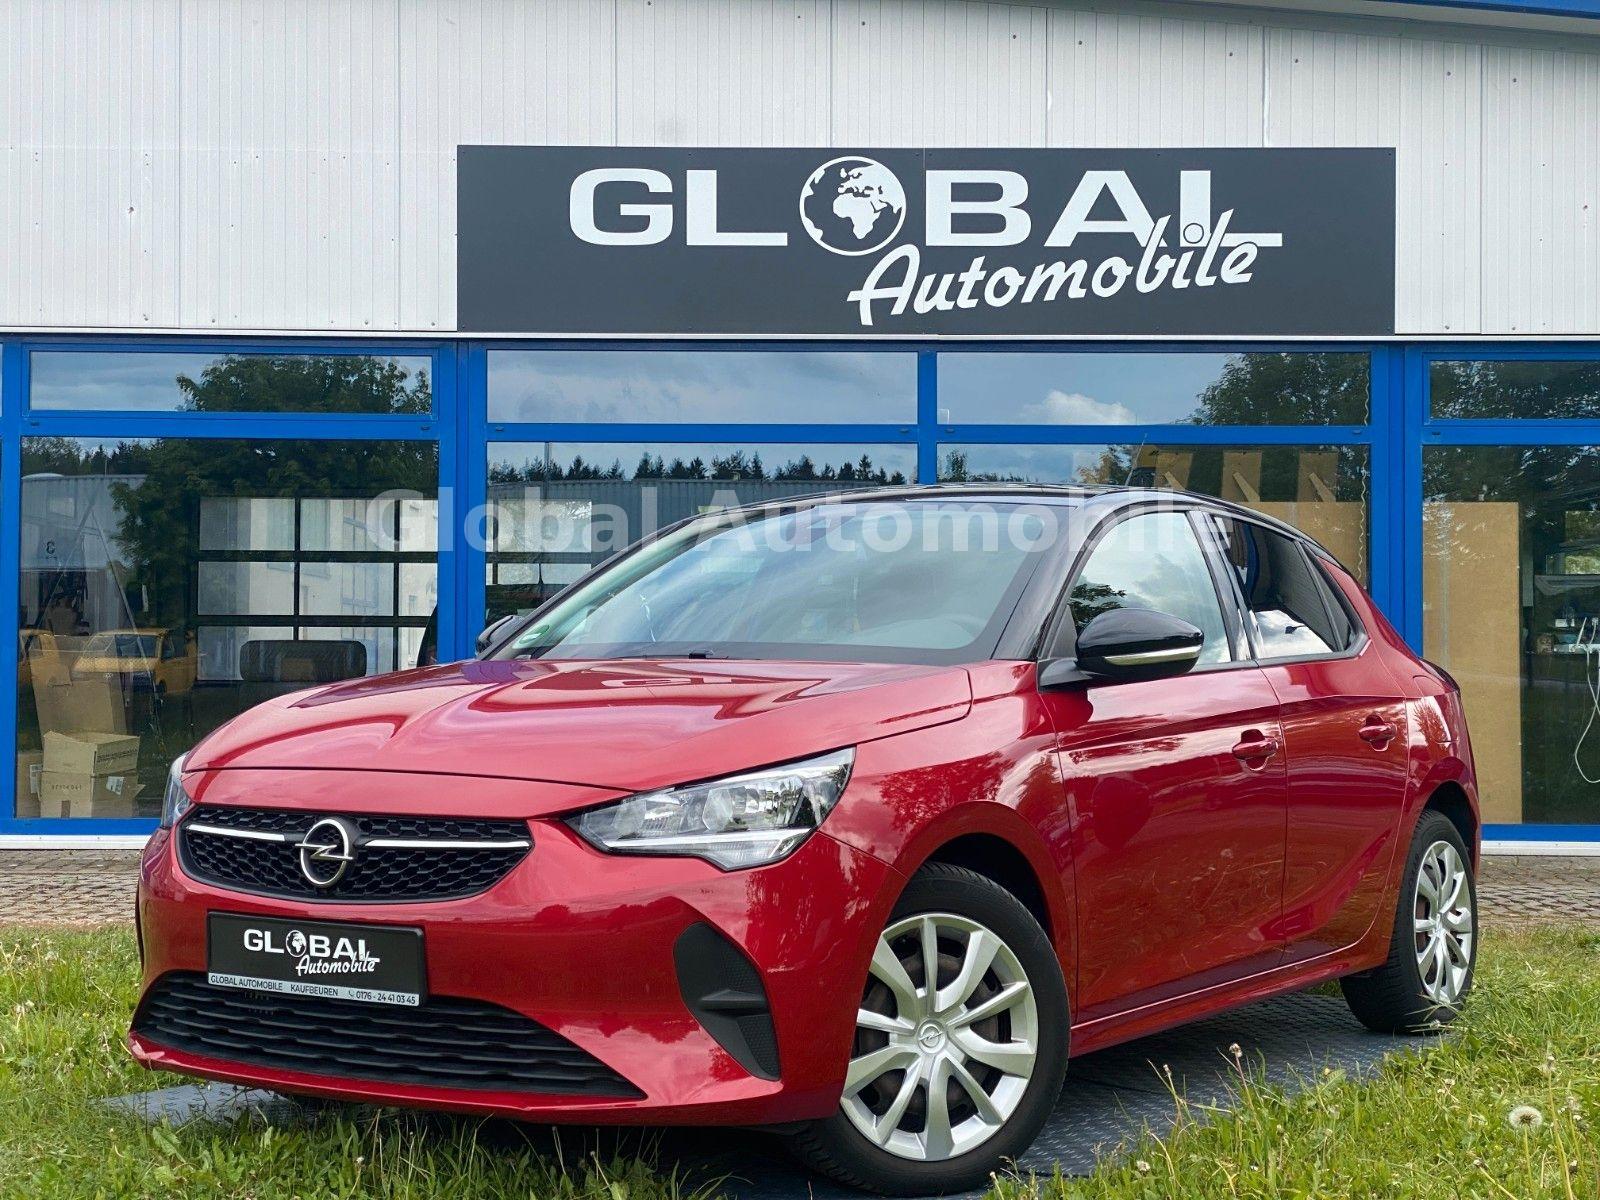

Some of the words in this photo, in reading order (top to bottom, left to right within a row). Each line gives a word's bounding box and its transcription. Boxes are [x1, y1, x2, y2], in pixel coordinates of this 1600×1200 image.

[570, 157, 1282, 255] GLOBAL
[848, 208, 1259, 326] Automobile
[243, 928, 380, 962] GLOBAL
[295, 951, 376, 977] Automobile
[210, 975, 239, 986] GLOBAL
[239, 978, 283, 991] AUTOMOBILE
[290, 984, 339, 996] KAUFBEUREN
[355, 990, 372, 1000] 0176
[377, 993, 387, 1001] 24
[387, 994, 395, 1002] 41
[396, 995, 405, 1004] 03
[406, 996, 416, 1005] 45
